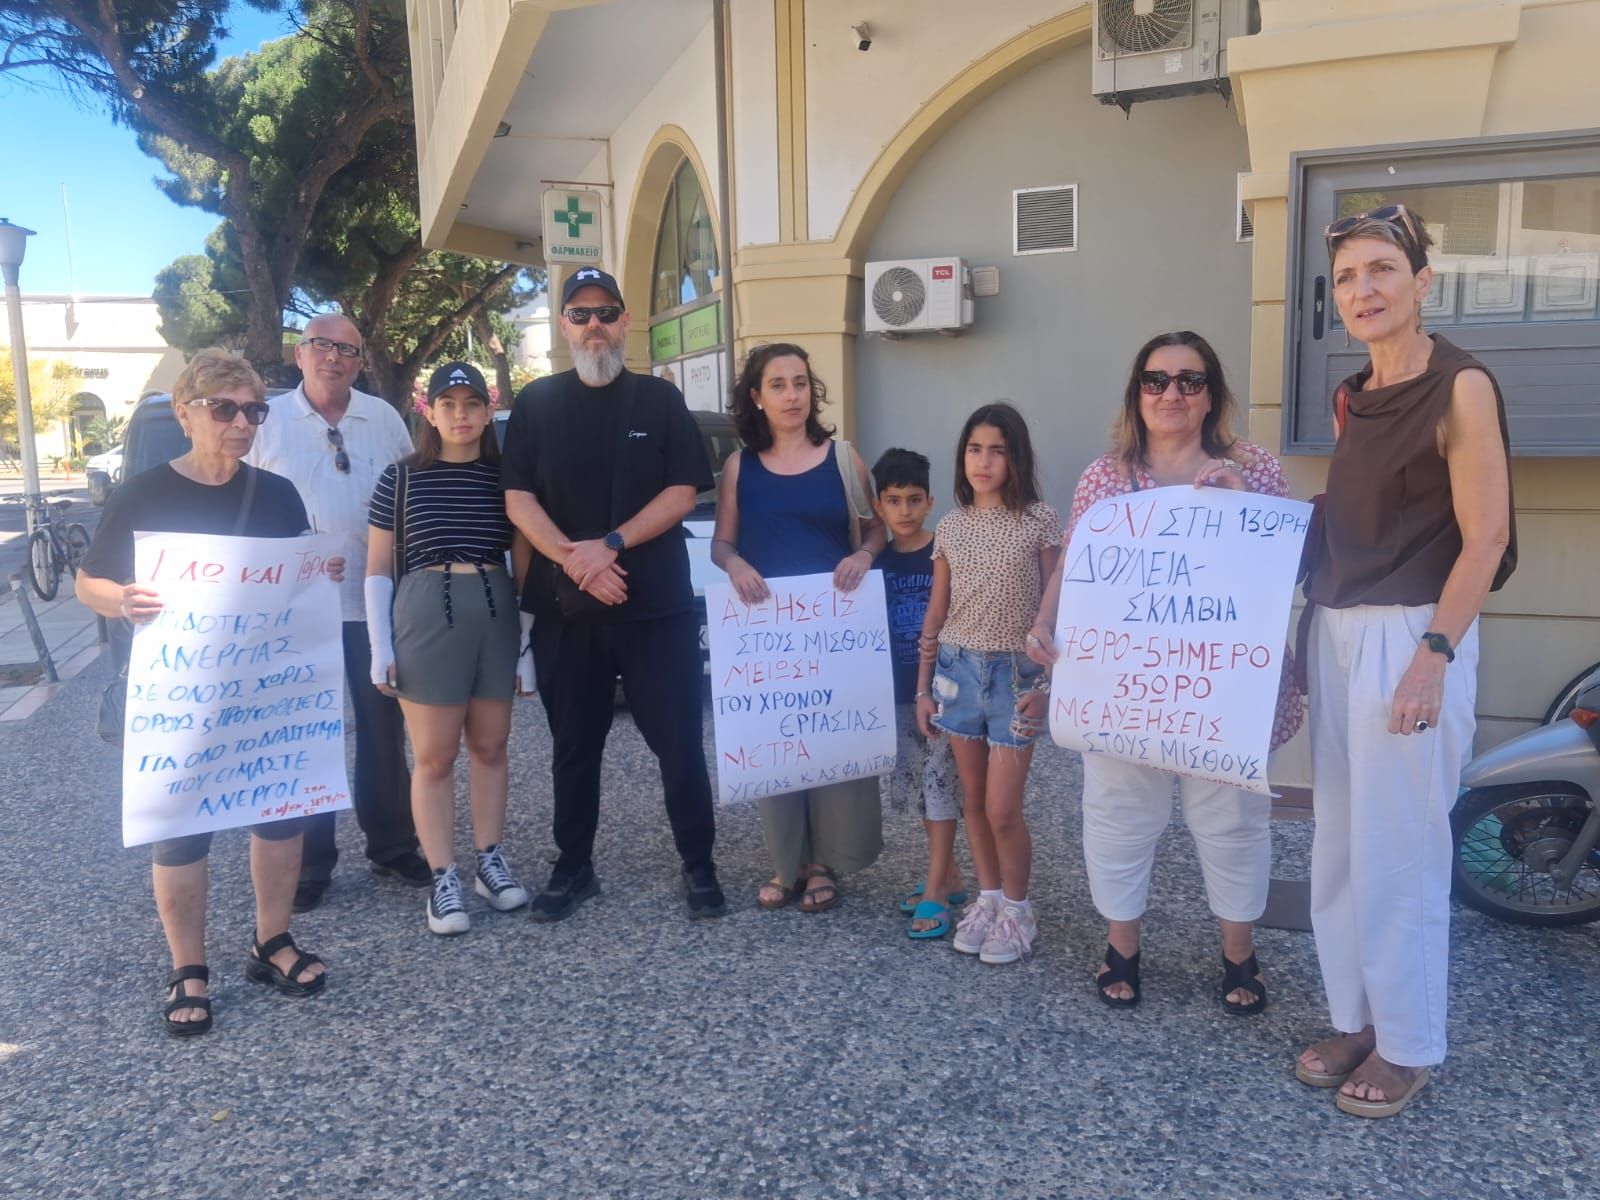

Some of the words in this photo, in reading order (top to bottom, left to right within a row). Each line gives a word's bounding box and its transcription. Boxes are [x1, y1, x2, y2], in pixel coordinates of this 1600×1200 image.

[551, 246, 599, 257] ΦΑΡΜΑΚΕΙΟ
[691, 366, 711, 384] PHYTO
[1088, 499, 1156, 539] ΟΧΙ
[1158, 506, 1223, 537] ΣΤΗ
[1239, 507, 1308, 537] 13ΩΡΗ
[721, 591, 860, 628] ΑΥΞΗΣΕΙΣ
[1122, 591, 1237, 625] ΣΚΛΑΒΙΑ
[735, 631, 795, 656] ΣΤΟΥΣ
[804, 628, 887, 654] ΜΙΣΘΟΥΣ
[724, 659, 819, 688] ΜΕΙΩΣΗ
[1113, 673, 1212, 703] 35ΩΡΟ
[167, 679, 245, 704] ΟΛΟΥΣ
[716, 695, 751, 715] ΤΟΥ
[760, 689, 833, 714] ΧΡΟΝΟΥ
[131, 713, 195, 733] ΟΡΟΥΣ
[779, 706, 888, 738] ΕΡΓΑΣΙΑΣ
[1055, 697, 1094, 728] ΜΕ
[1100, 703, 1224, 743] ΑΥΞΗΣΕΙΣ
[138, 755, 177, 772] ΓΙΑ
[184, 744, 226, 769] ΟΛΟ
[723, 740, 812, 770] ΜΕΤΡΑ
[1082, 731, 1150, 760] ΣΤΟΥΣ
[1160, 737, 1264, 780] ΜΙΣΘΟΥΣ
[164, 773, 211, 795] ΠΟΥ
[214, 751, 311, 784] ΕΙΜΑΣΤΕ
[195, 778, 300, 817] ΑΝΕΡΓΟΙ
